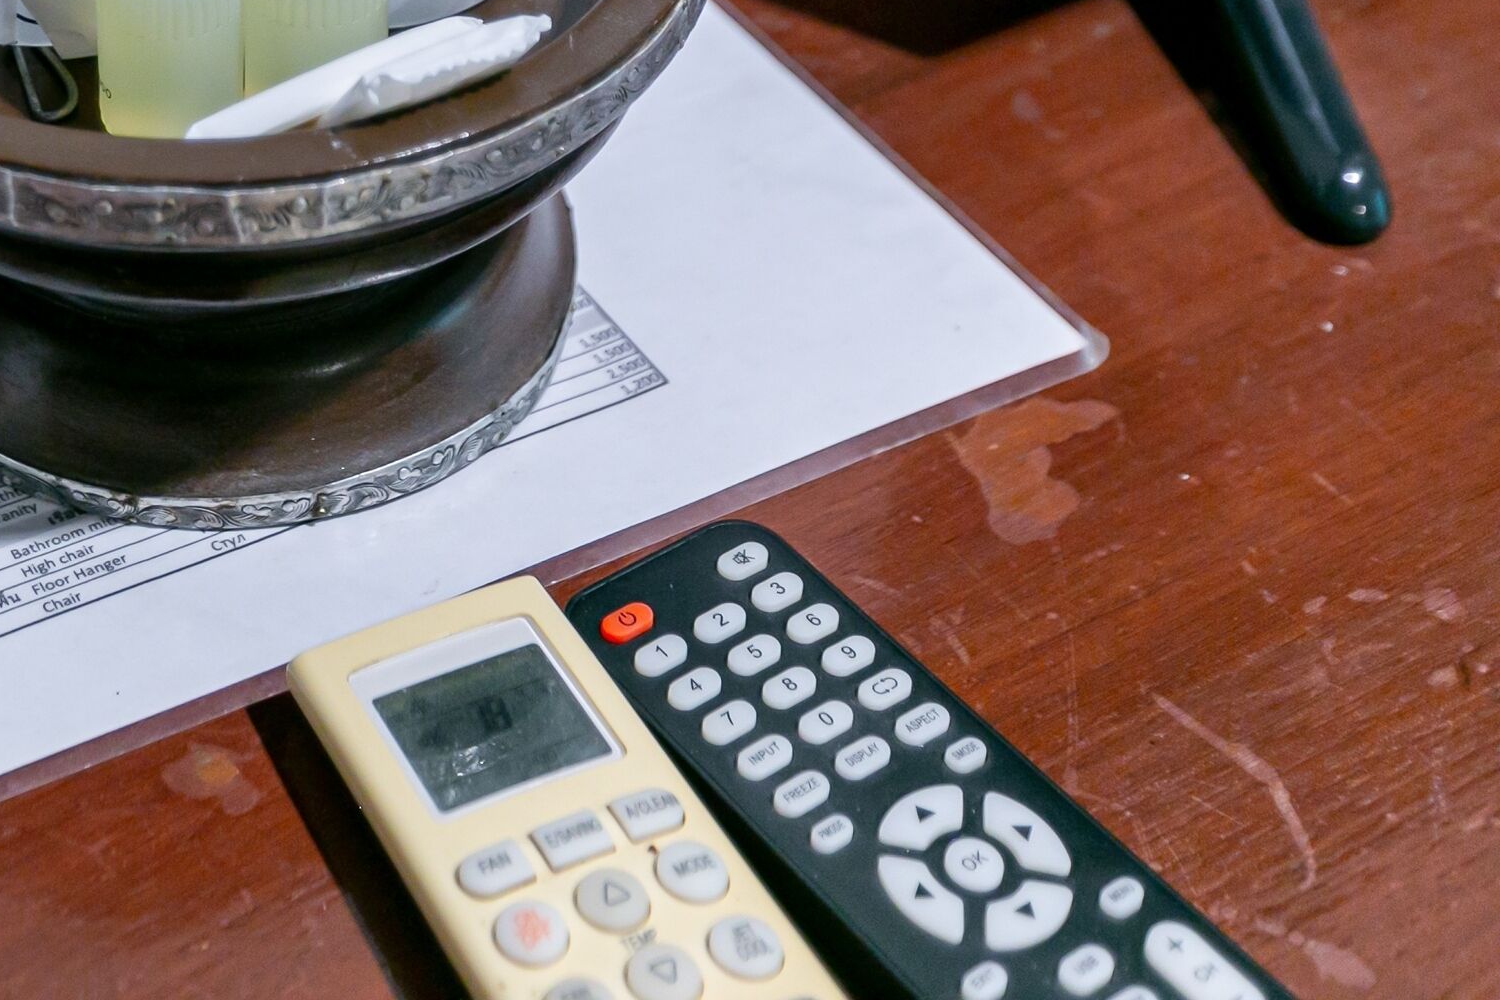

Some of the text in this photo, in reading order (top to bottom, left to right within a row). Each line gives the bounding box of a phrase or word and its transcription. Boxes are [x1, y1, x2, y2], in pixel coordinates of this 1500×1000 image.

[11, 527, 86, 560] Bathroom
[211, 534, 246, 551] Стул
[21, 558, 56, 578] High
[59, 544, 95, 565] chair
[32, 575, 70, 596] Floor
[74, 554, 127, 581] Hanger
[769, 581, 787, 595] 3
[42, 592, 82, 613] Chair
[712, 612, 730, 627] 2
[806, 613, 822, 626] 6
[655, 645, 669, 658] 1
[747, 645, 763, 659] 5
[841, 645, 857, 659] 9
[690, 678, 703, 691] 4
[782, 678, 798, 691] 8
[720, 711, 734, 726] 7
[818, 711, 835, 726] 0
[905, 708, 940, 733] ASPECT
[747, 740, 782, 766] INPUT
[844, 742, 881, 768] DISPLAY
[782, 776, 821, 803] FREEZE
[478, 853, 512, 876] FAN
[672, 854, 716, 877] MODE
[961, 851, 989, 872] OK
[619, 928, 659, 951] TEMP
